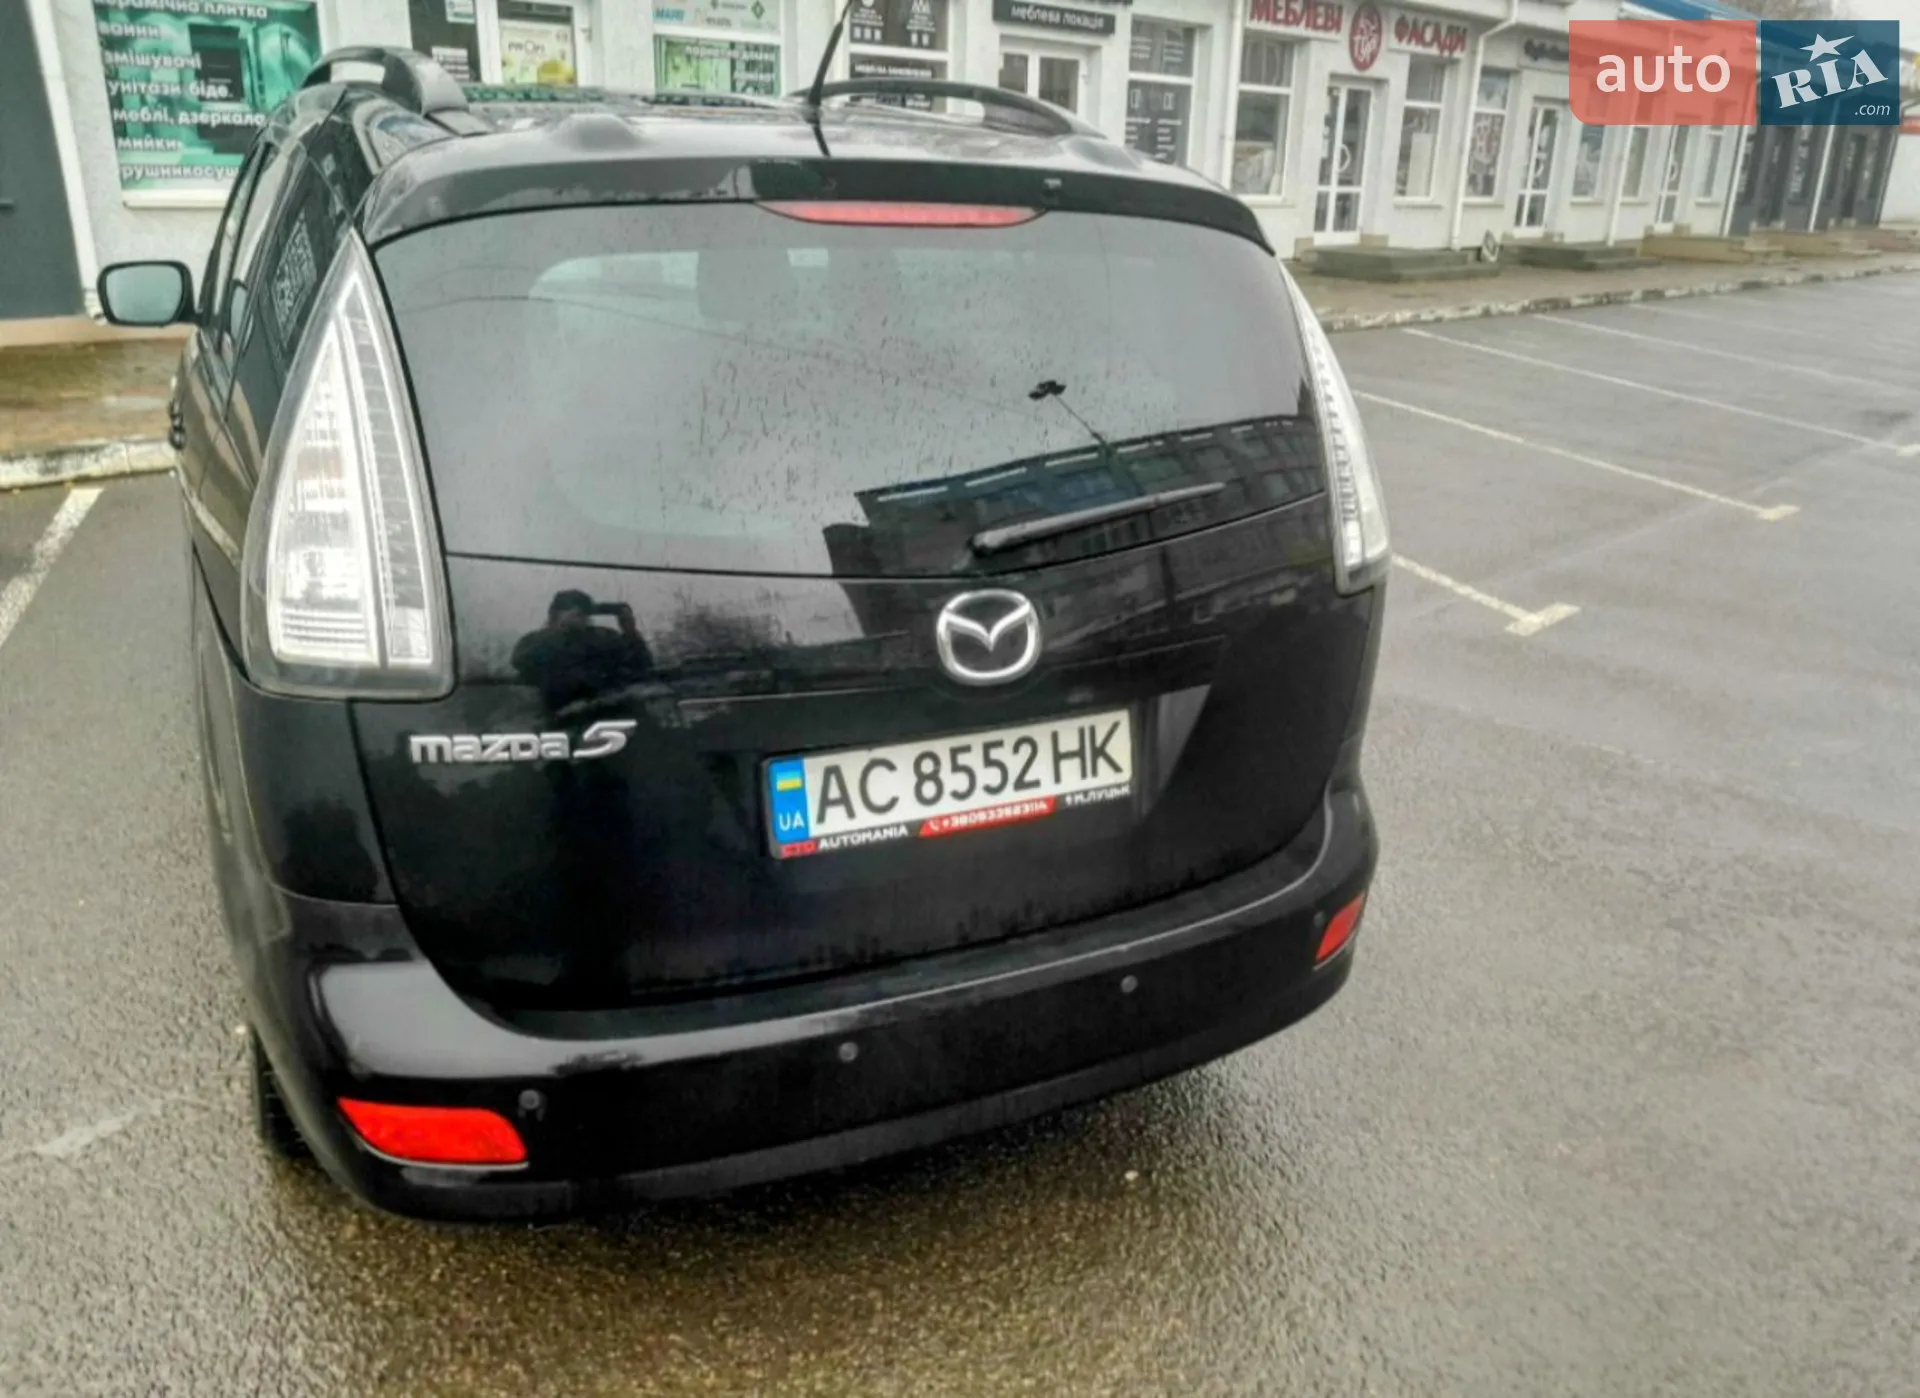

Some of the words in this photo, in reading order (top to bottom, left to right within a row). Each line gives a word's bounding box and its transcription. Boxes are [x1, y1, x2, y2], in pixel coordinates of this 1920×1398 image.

[204, 3, 268, 19] плитка
[1394, 14, 1468, 55] ФАСАДИ
[573, 719, 638, 759] 5
[816, 757, 900, 825] AC
[913, 735, 1042, 807] 8552
[1050, 721, 1124, 784] HK
[777, 810, 806, 832] UA
[818, 823, 910, 853] AUTOMANIA
